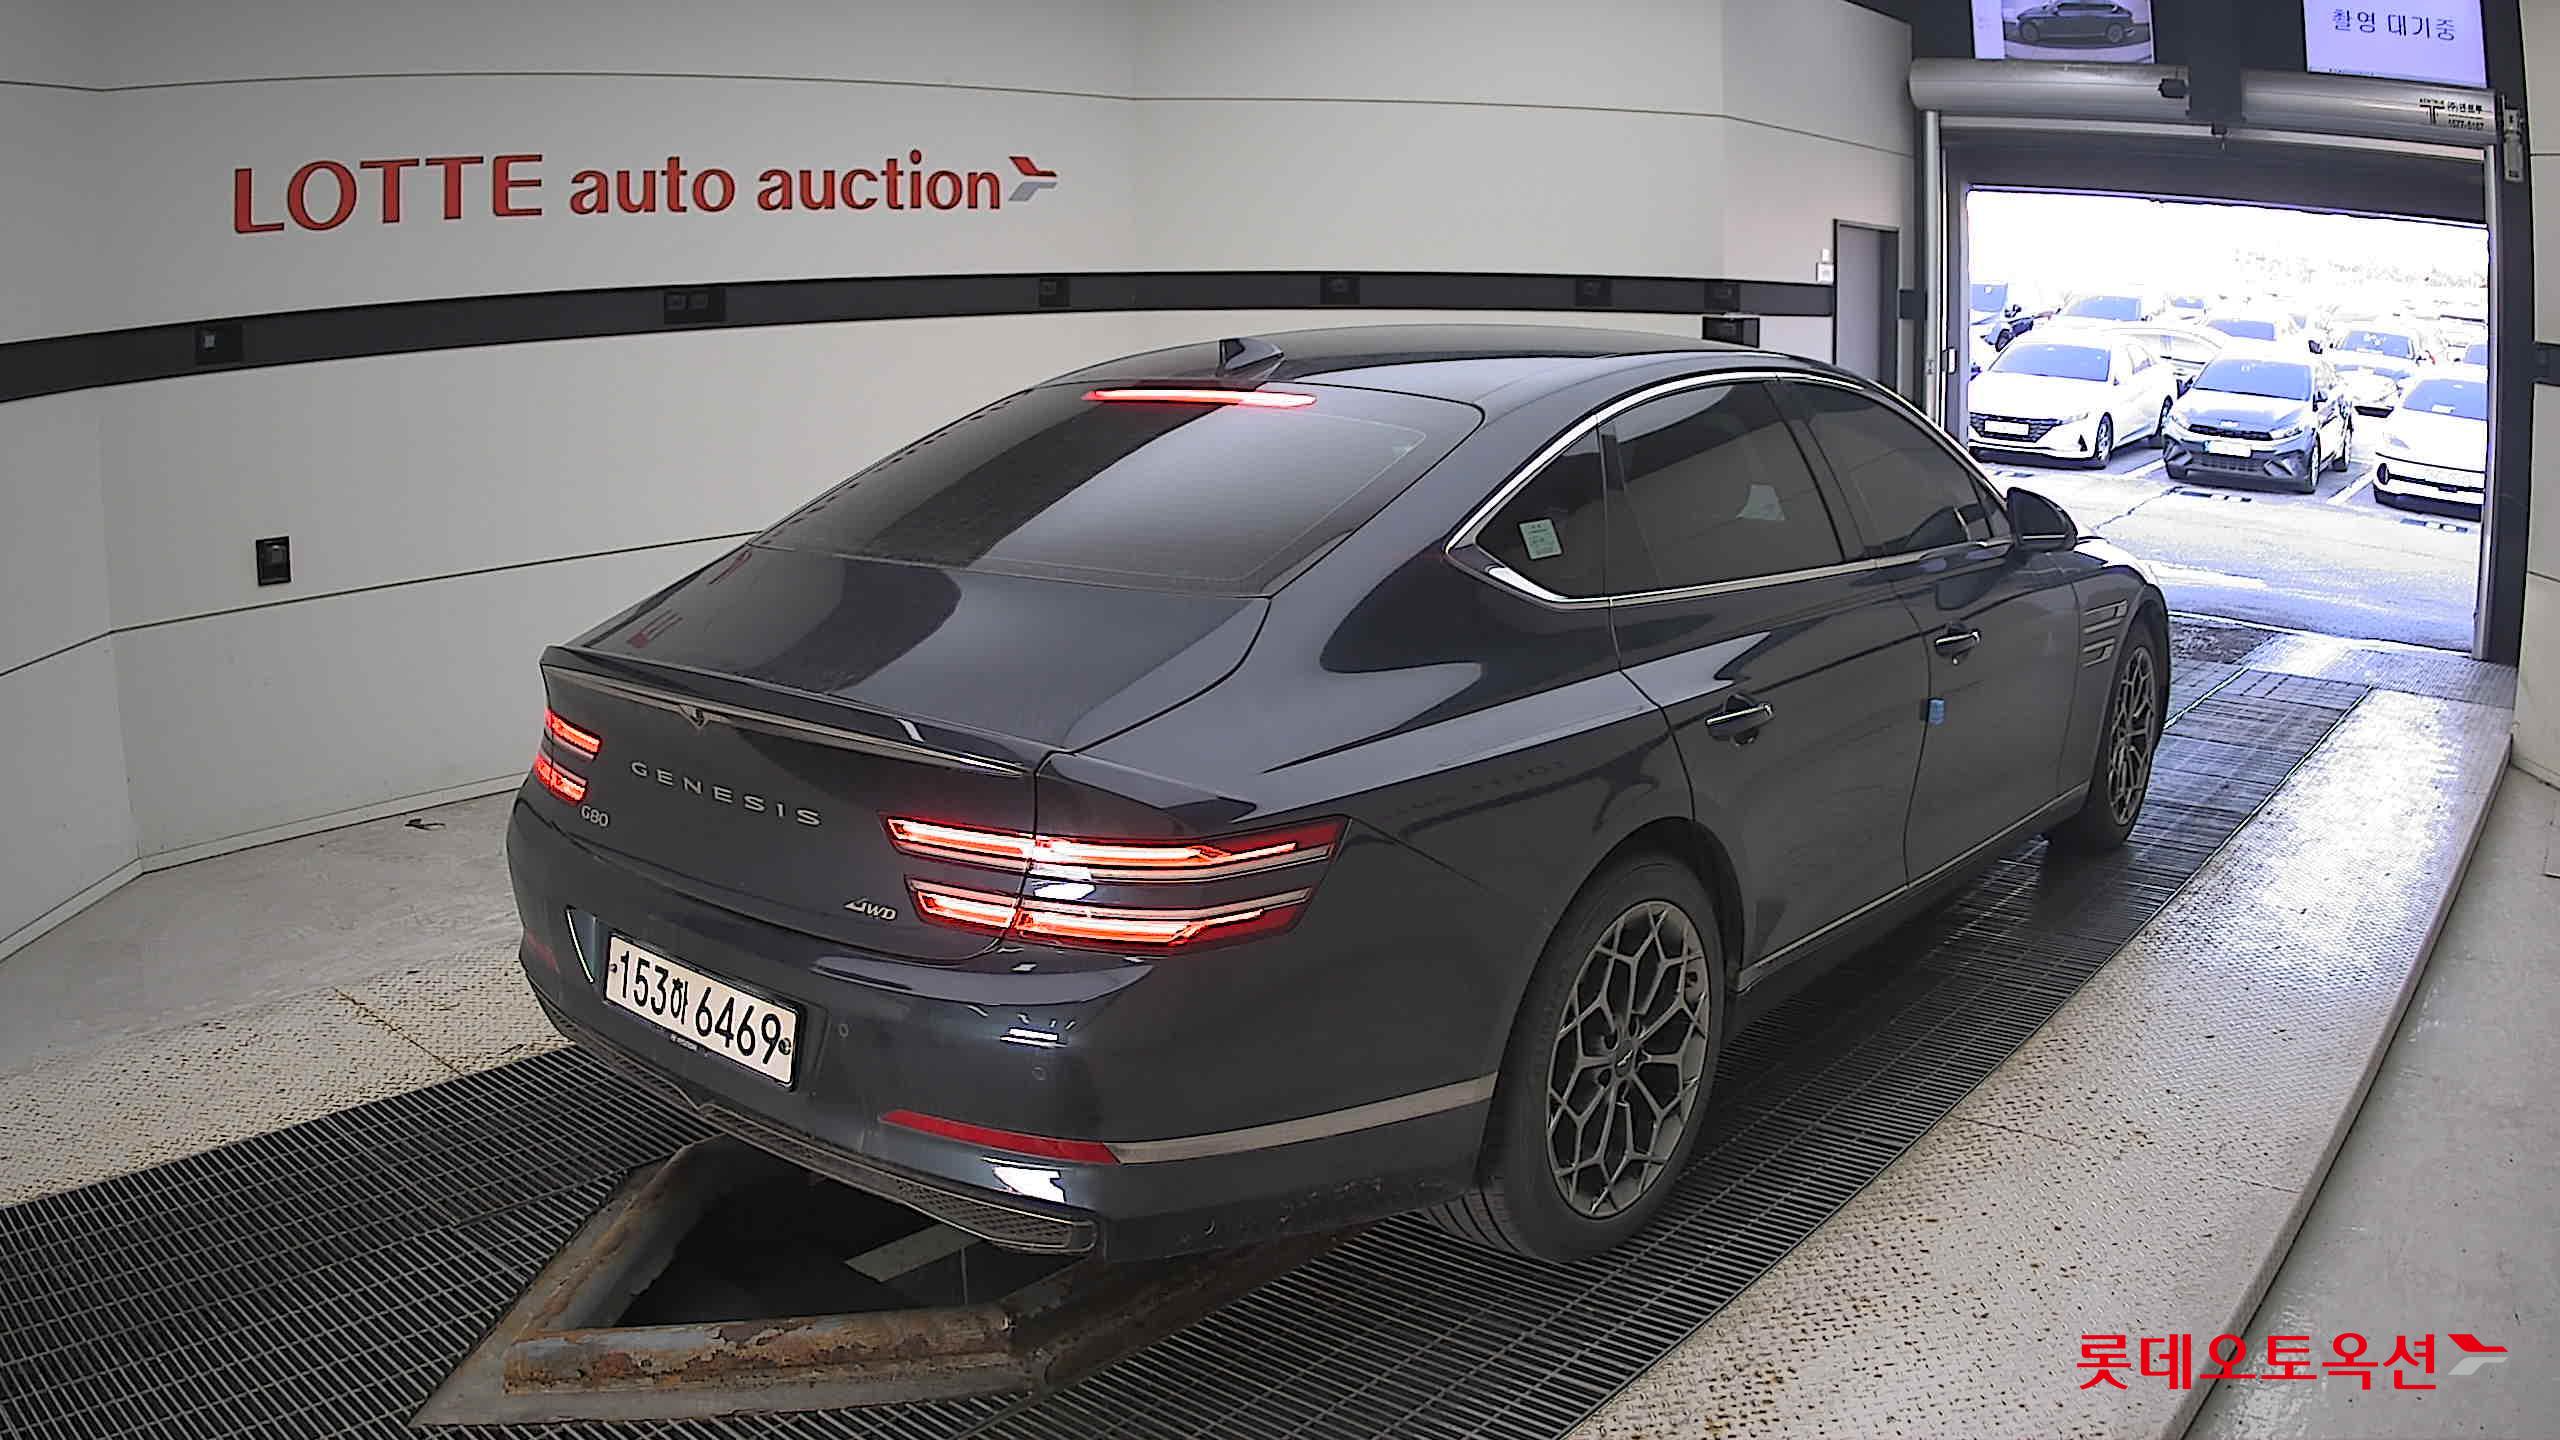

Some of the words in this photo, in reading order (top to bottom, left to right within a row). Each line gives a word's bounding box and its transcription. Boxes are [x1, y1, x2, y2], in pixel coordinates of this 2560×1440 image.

[234, 153, 541, 233] LOTTE
[570, 155, 736, 214] auto
[757, 149, 1001, 210] auction
[580, 804, 609, 827] G80
[631, 761, 821, 827] GENESIS
[844, 898, 897, 920] AWD
